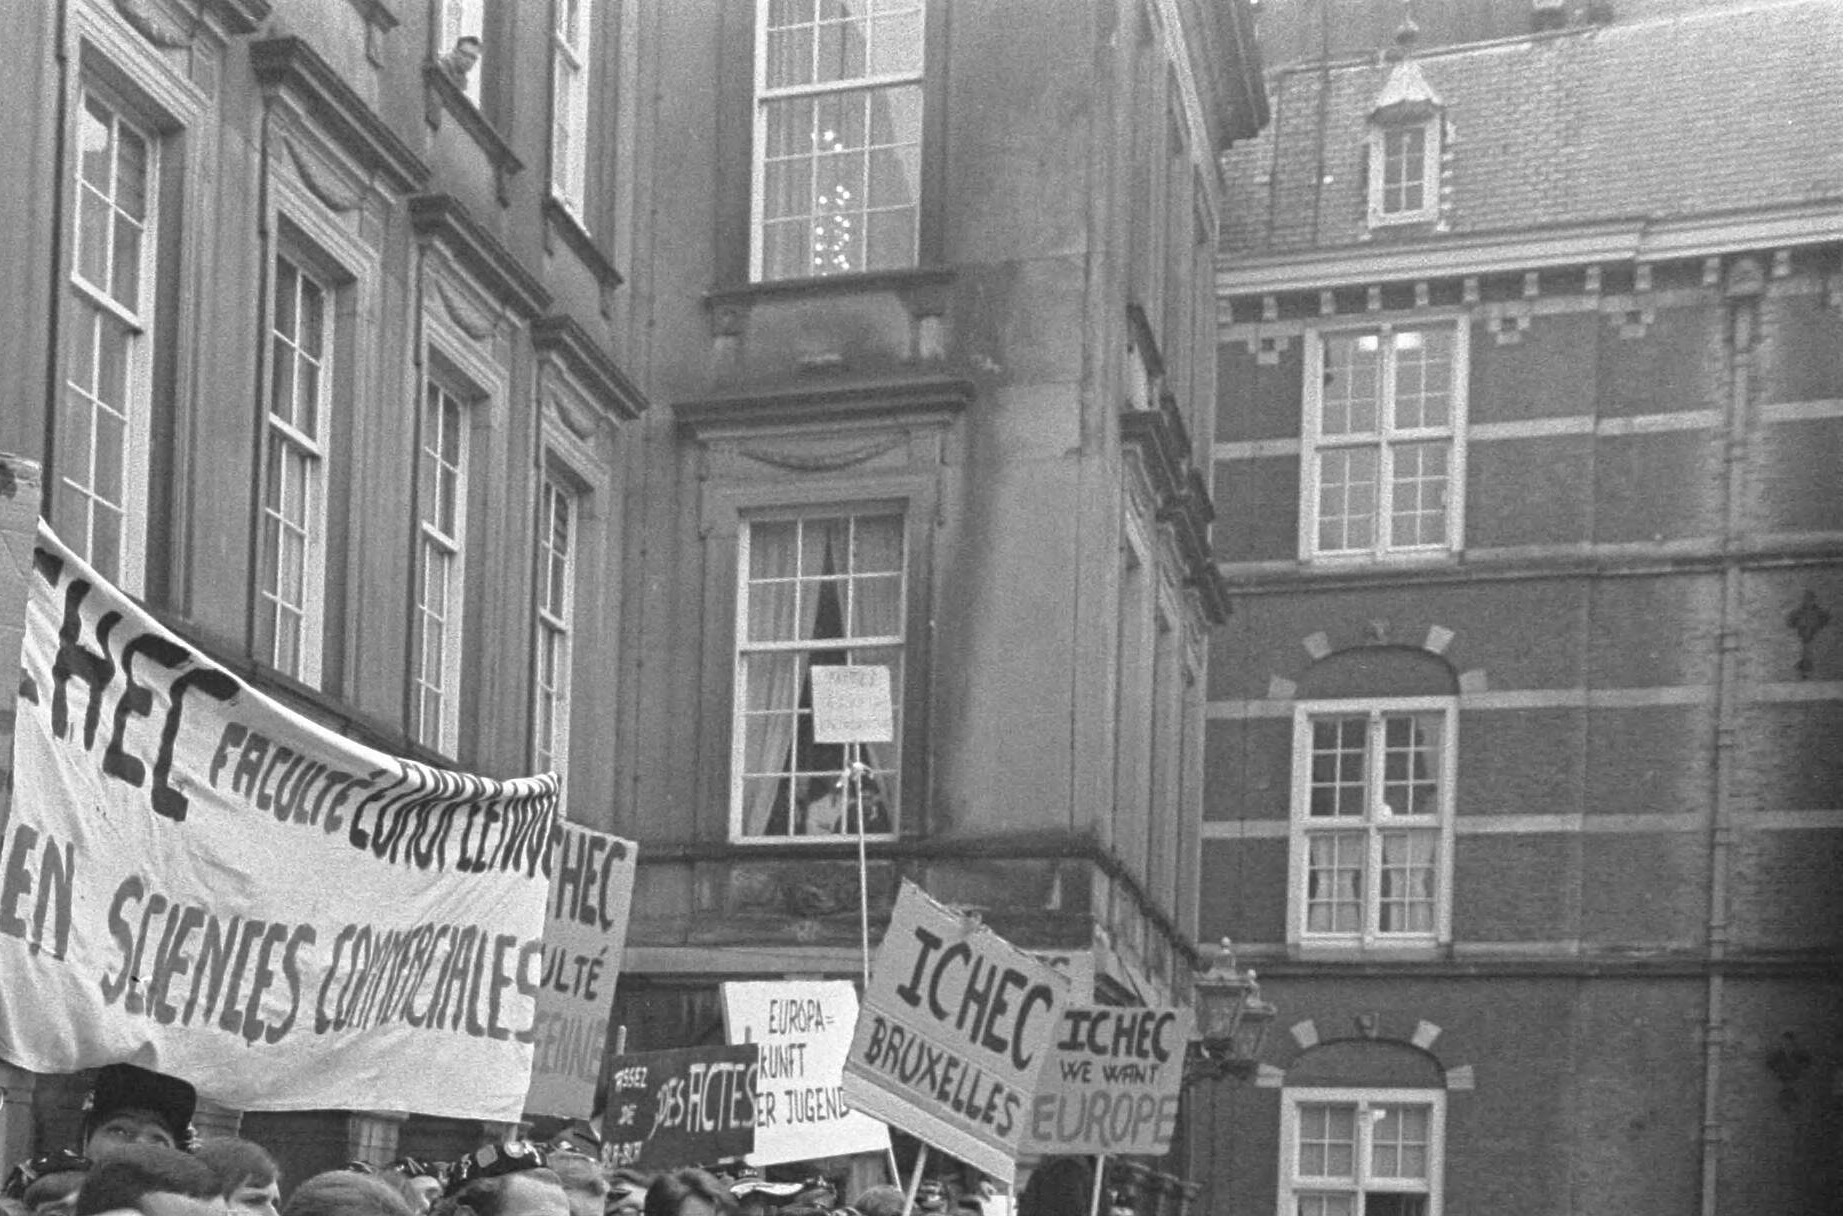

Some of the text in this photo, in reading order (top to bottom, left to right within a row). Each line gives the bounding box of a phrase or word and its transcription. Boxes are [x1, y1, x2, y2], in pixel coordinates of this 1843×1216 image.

[19, 547, 241, 823] HEC
[554, 824, 628, 933] HEC
[99, 874, 317, 1047] SCIENCES
[895, 925, 1054, 1072] ICHEC
[864, 1016, 1021, 1138] BRUXELLES
[1058, 1010, 1176, 1063] ICHEC
[1060, 1060, 1159, 1085] WE WANT
[686, 1061, 757, 1132] ACTES
[785, 1086, 850, 1125] JUGEND
[1031, 1089, 1179, 1146] EUROPE
